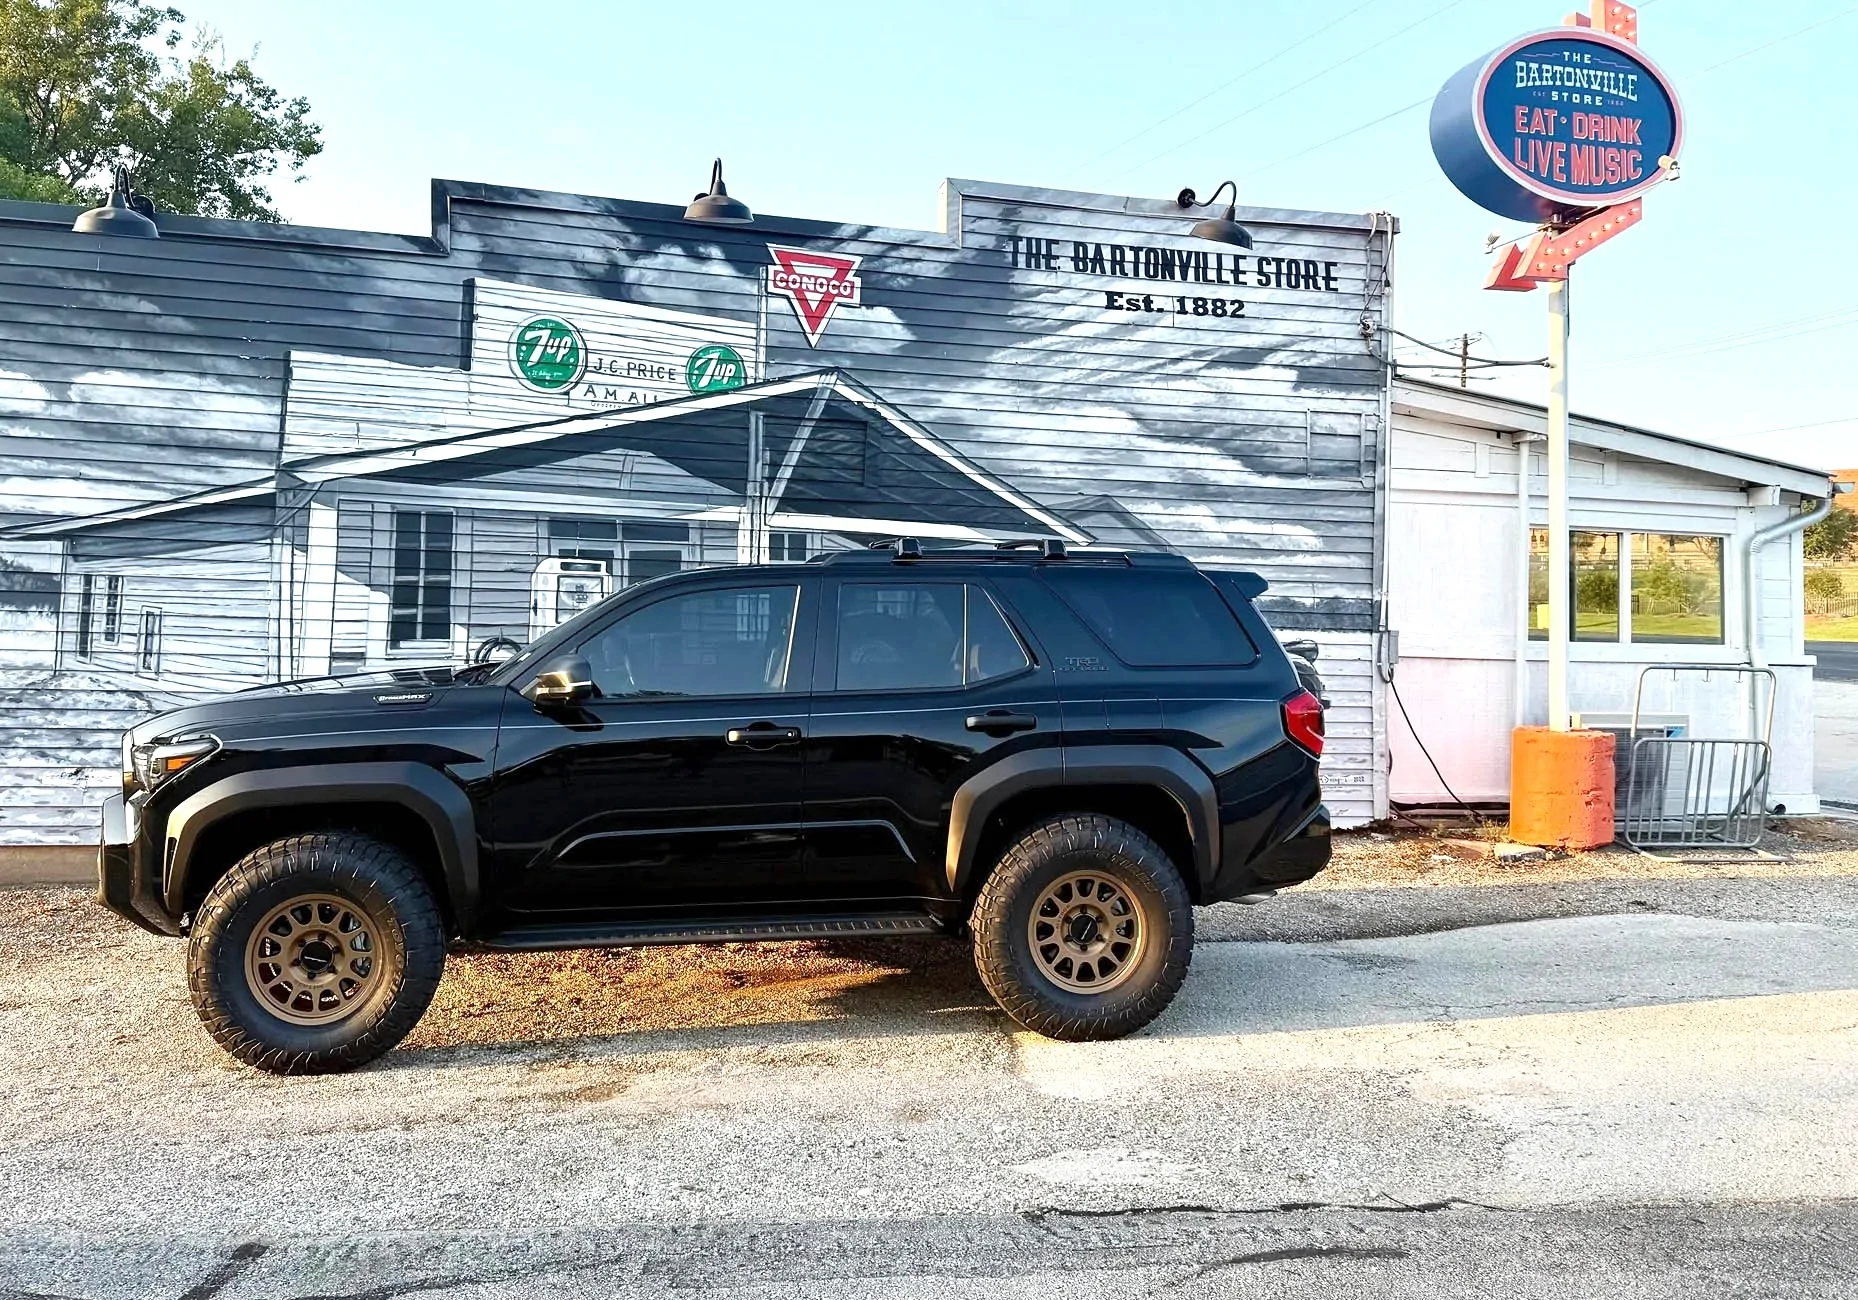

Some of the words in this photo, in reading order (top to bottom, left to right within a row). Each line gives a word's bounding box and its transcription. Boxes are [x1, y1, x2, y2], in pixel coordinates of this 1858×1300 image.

[1563, 51, 1592, 64] THE
[1515, 61, 1638, 102] BARTONVILLE
[1551, 90, 1603, 106] STORE
[1514, 105, 1558, 136] EAT
[1572, 111, 1643, 145] DRINK
[1514, 137, 1566, 183] LIVE
[1571, 143, 1643, 186] MUSIC
[1008, 236, 1061, 271] THE
[1071, 241, 1248, 286] BARTONVILLE
[1256, 257, 1340, 292] STORE
[775, 273, 852, 296] CONOCO
[1104, 291, 1165, 314] Est.
[1176, 297, 1246, 319] 1882
[626, 362, 677, 381] PRICE
